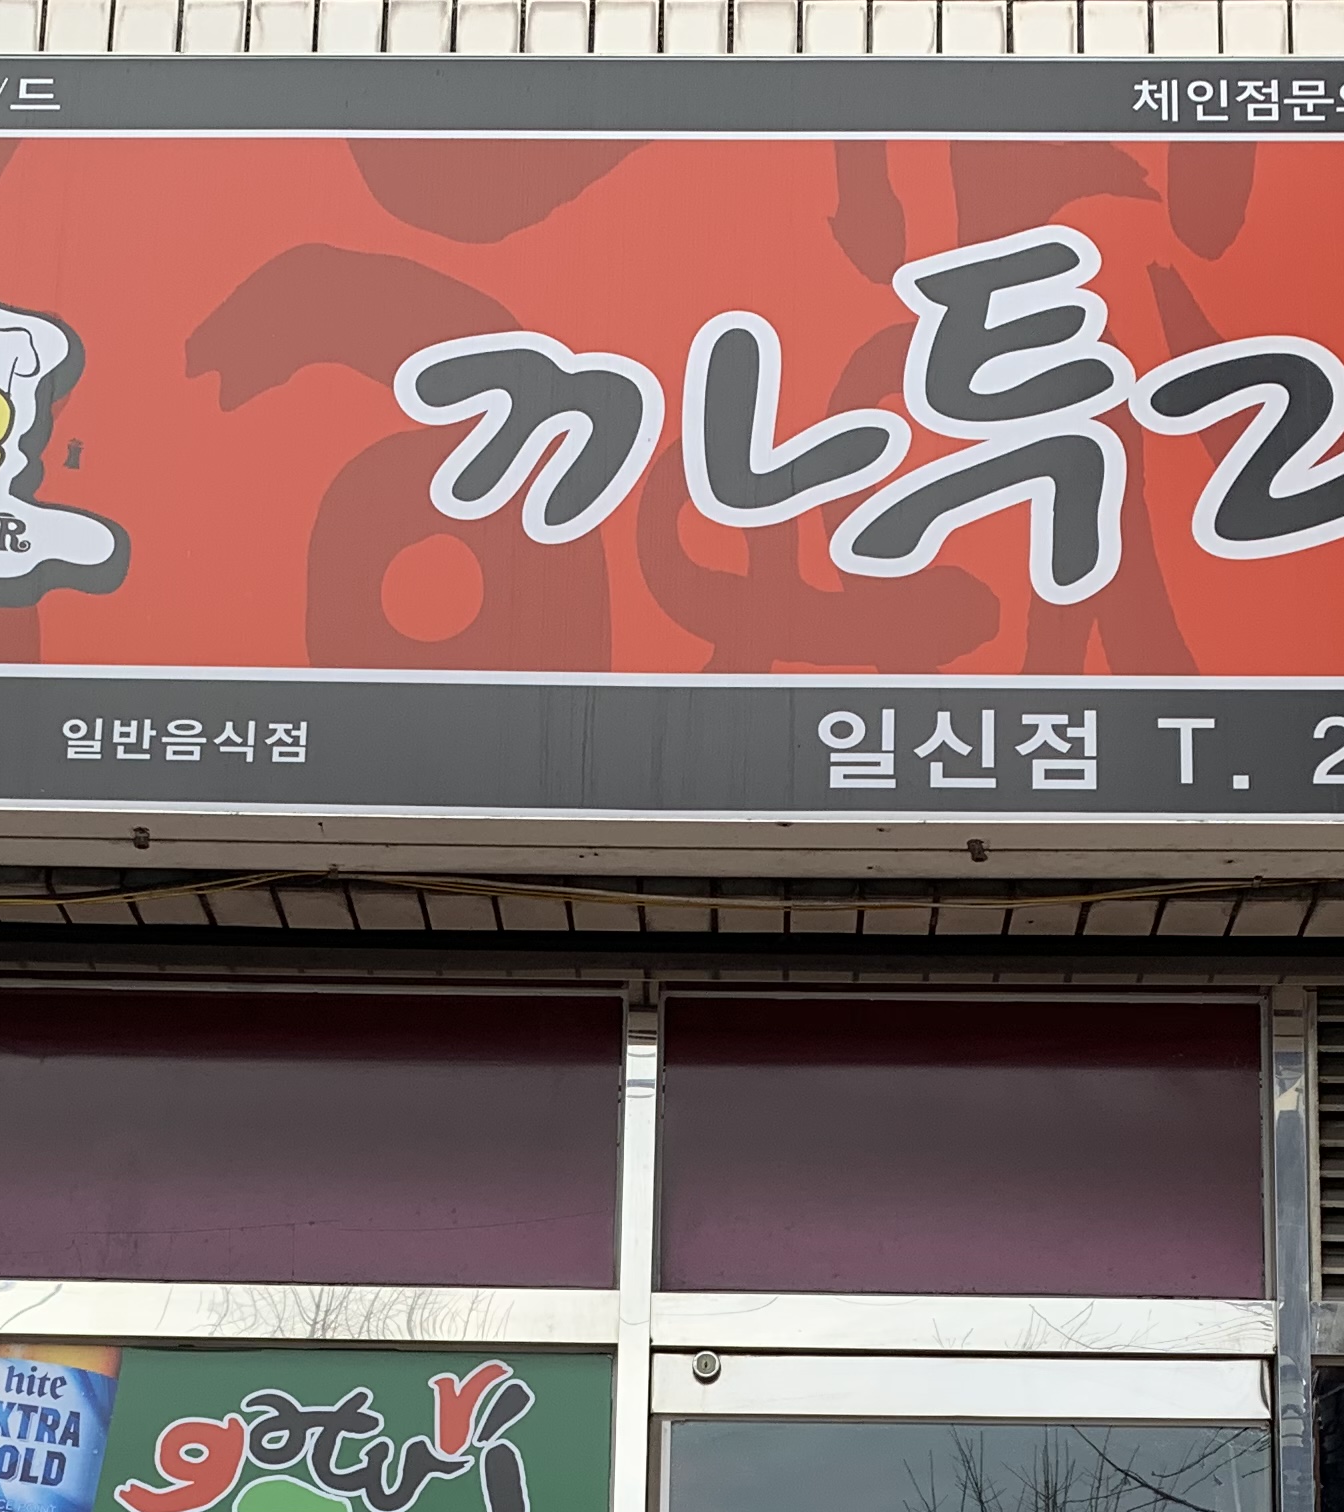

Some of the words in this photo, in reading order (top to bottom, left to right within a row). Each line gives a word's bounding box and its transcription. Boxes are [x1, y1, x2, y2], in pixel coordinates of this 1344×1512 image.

[60, 716, 311, 766] 일반음식점
[816, 708, 1101, 793] 일신점
[1154, 717, 1254, 790] T.
[6, 1365, 68, 1400] hite
